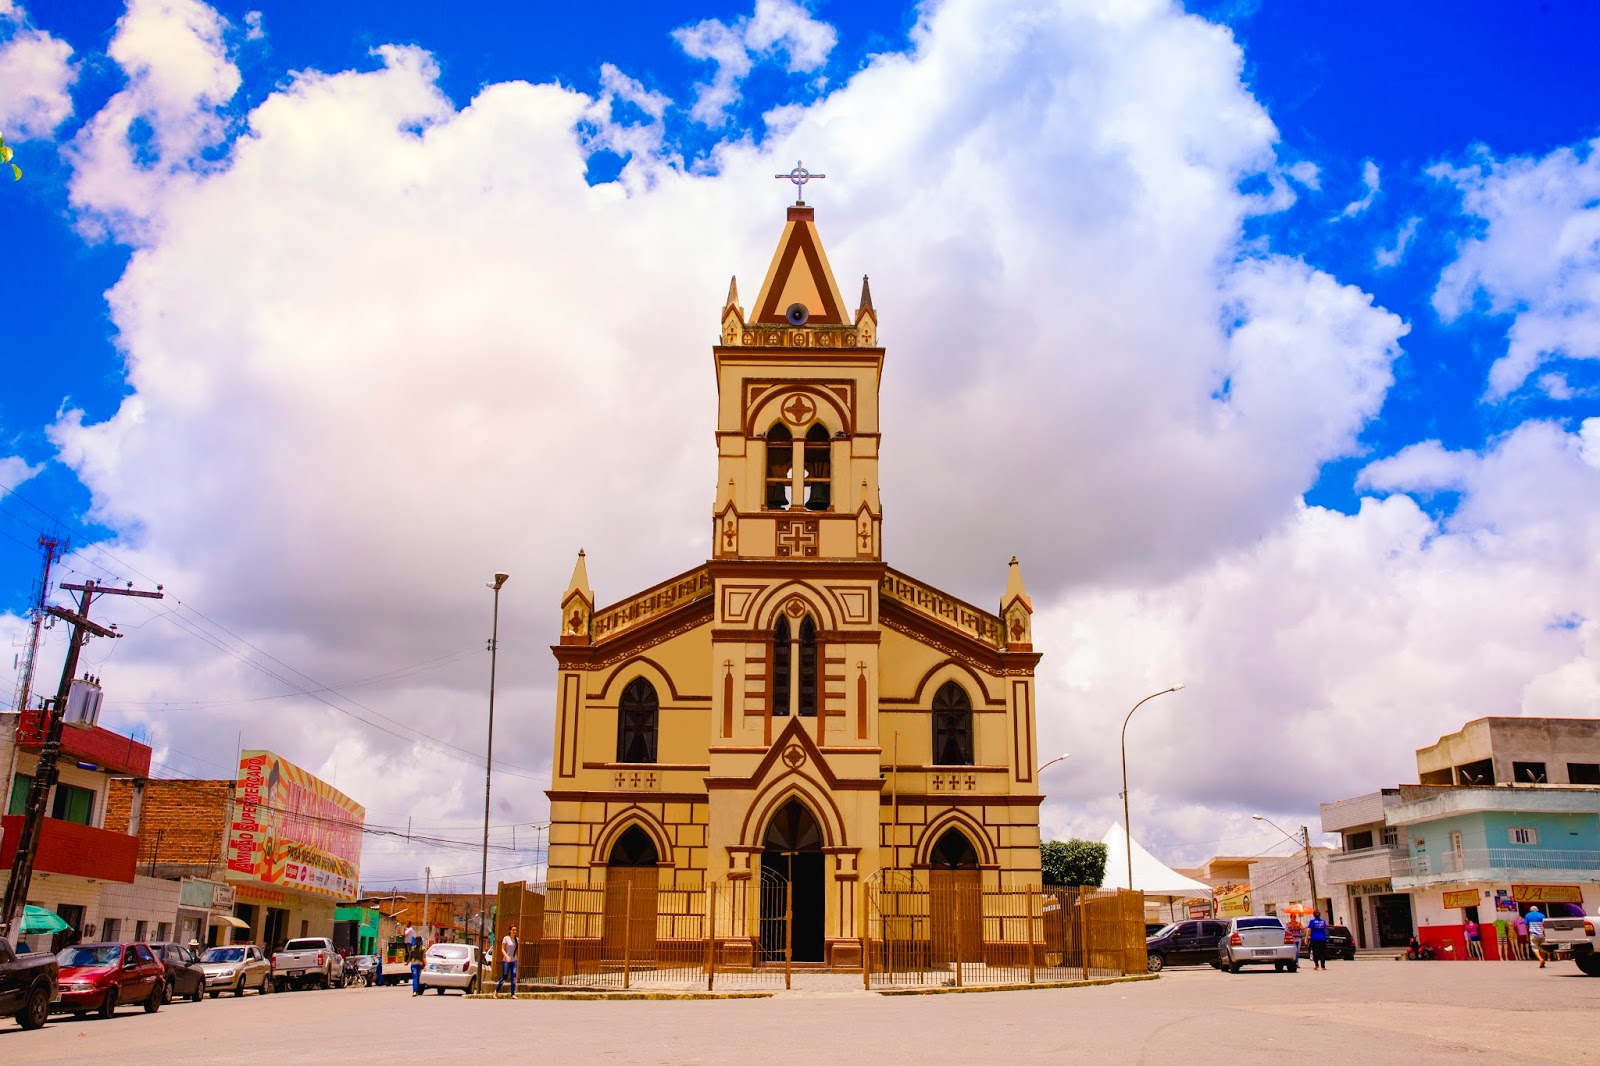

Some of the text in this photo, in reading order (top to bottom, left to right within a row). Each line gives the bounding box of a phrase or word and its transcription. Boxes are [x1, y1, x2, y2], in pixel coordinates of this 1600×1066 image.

[235, 758, 263, 871] AMIGÃO SUPERMERCADO
[287, 845, 301, 861] PARA
